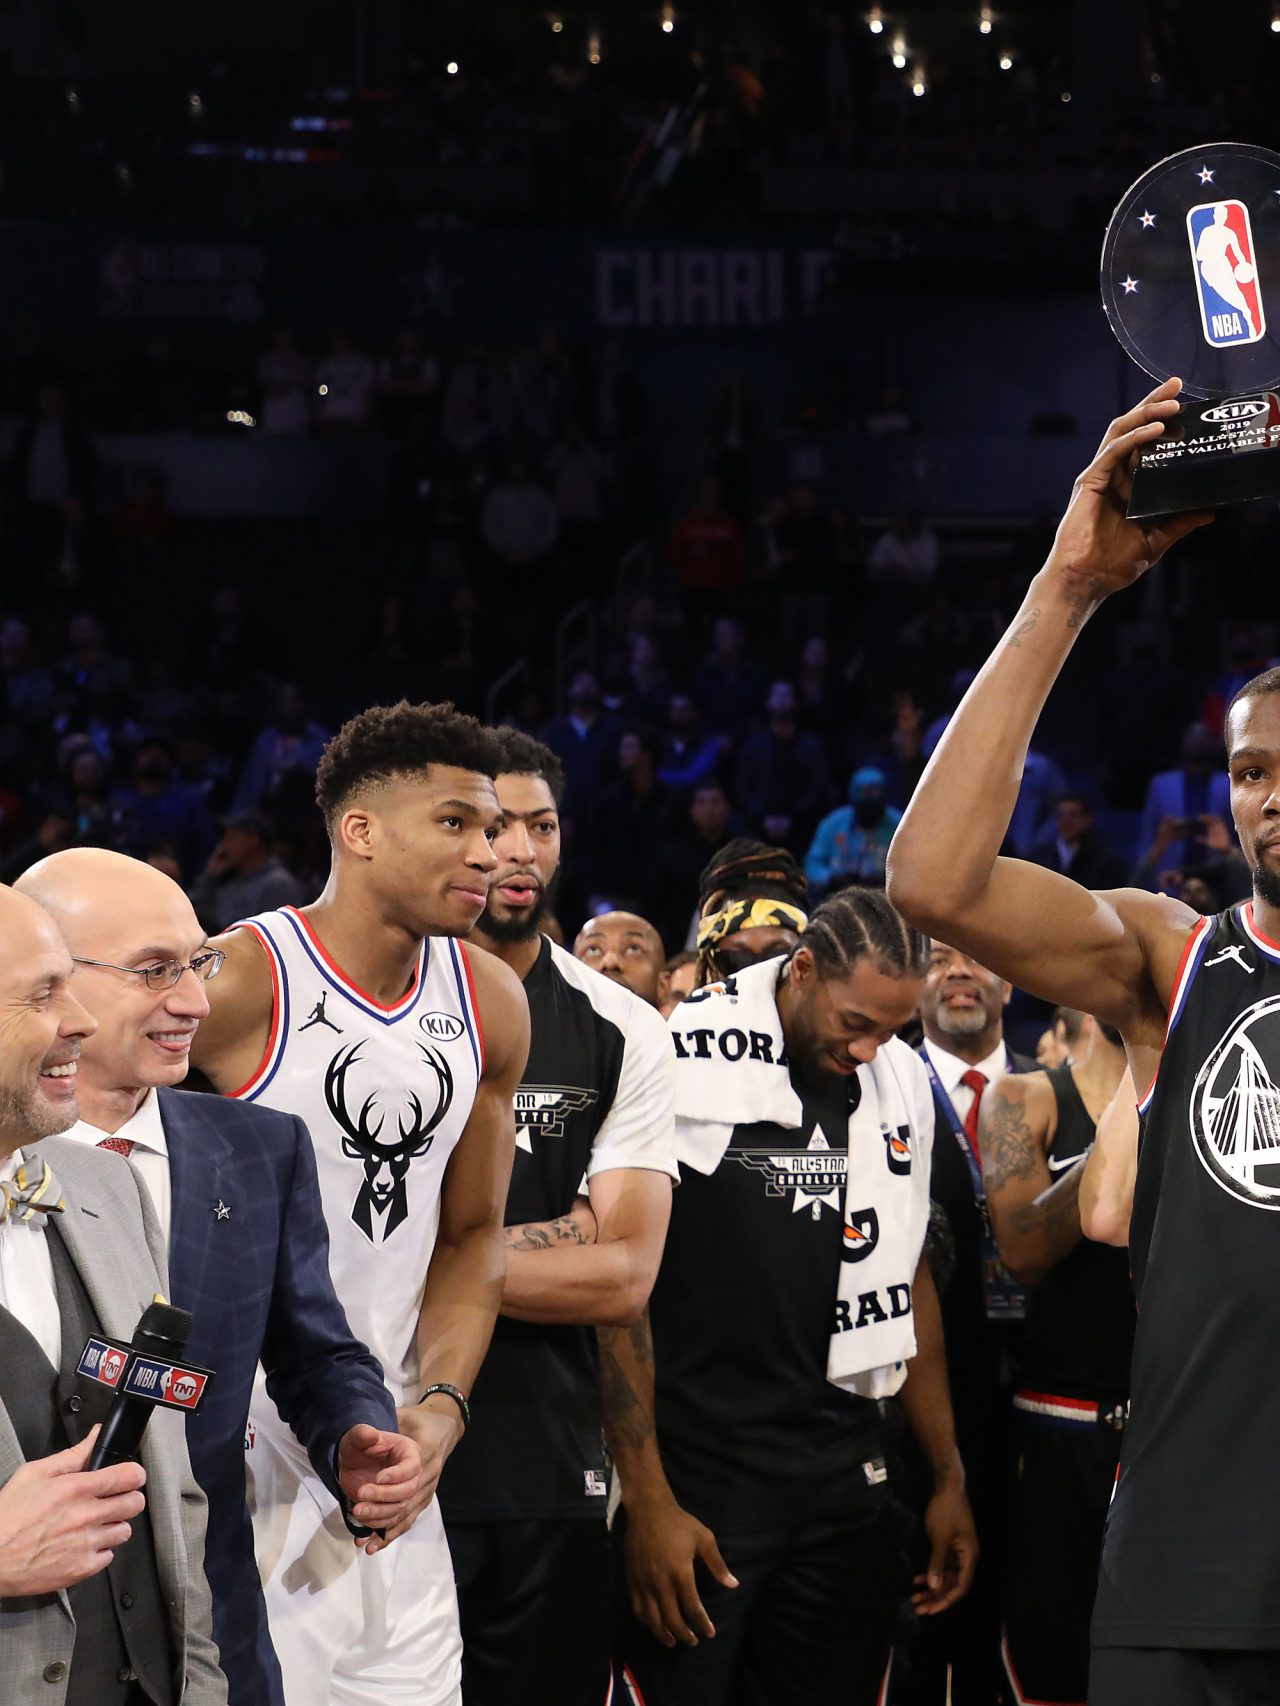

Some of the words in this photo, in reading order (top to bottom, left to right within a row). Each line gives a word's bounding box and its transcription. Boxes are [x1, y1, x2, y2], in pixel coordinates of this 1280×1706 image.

[1211, 312, 1243, 338] NBA
[1213, 403, 1258, 420] KIA
[1220, 421, 1250, 432] 2019
[1141, 450, 1184, 463] MOST
[1187, 436, 1266, 455] VALUABLE
[1156, 440, 1189, 451] NBA
[425, 1018, 457, 1035] KIA
[83, 1347, 101, 1370] NBA
[105, 1362, 120, 1375] TNT
[133, 1366, 159, 1390] NBA
[174, 1382, 198, 1396] TNT
